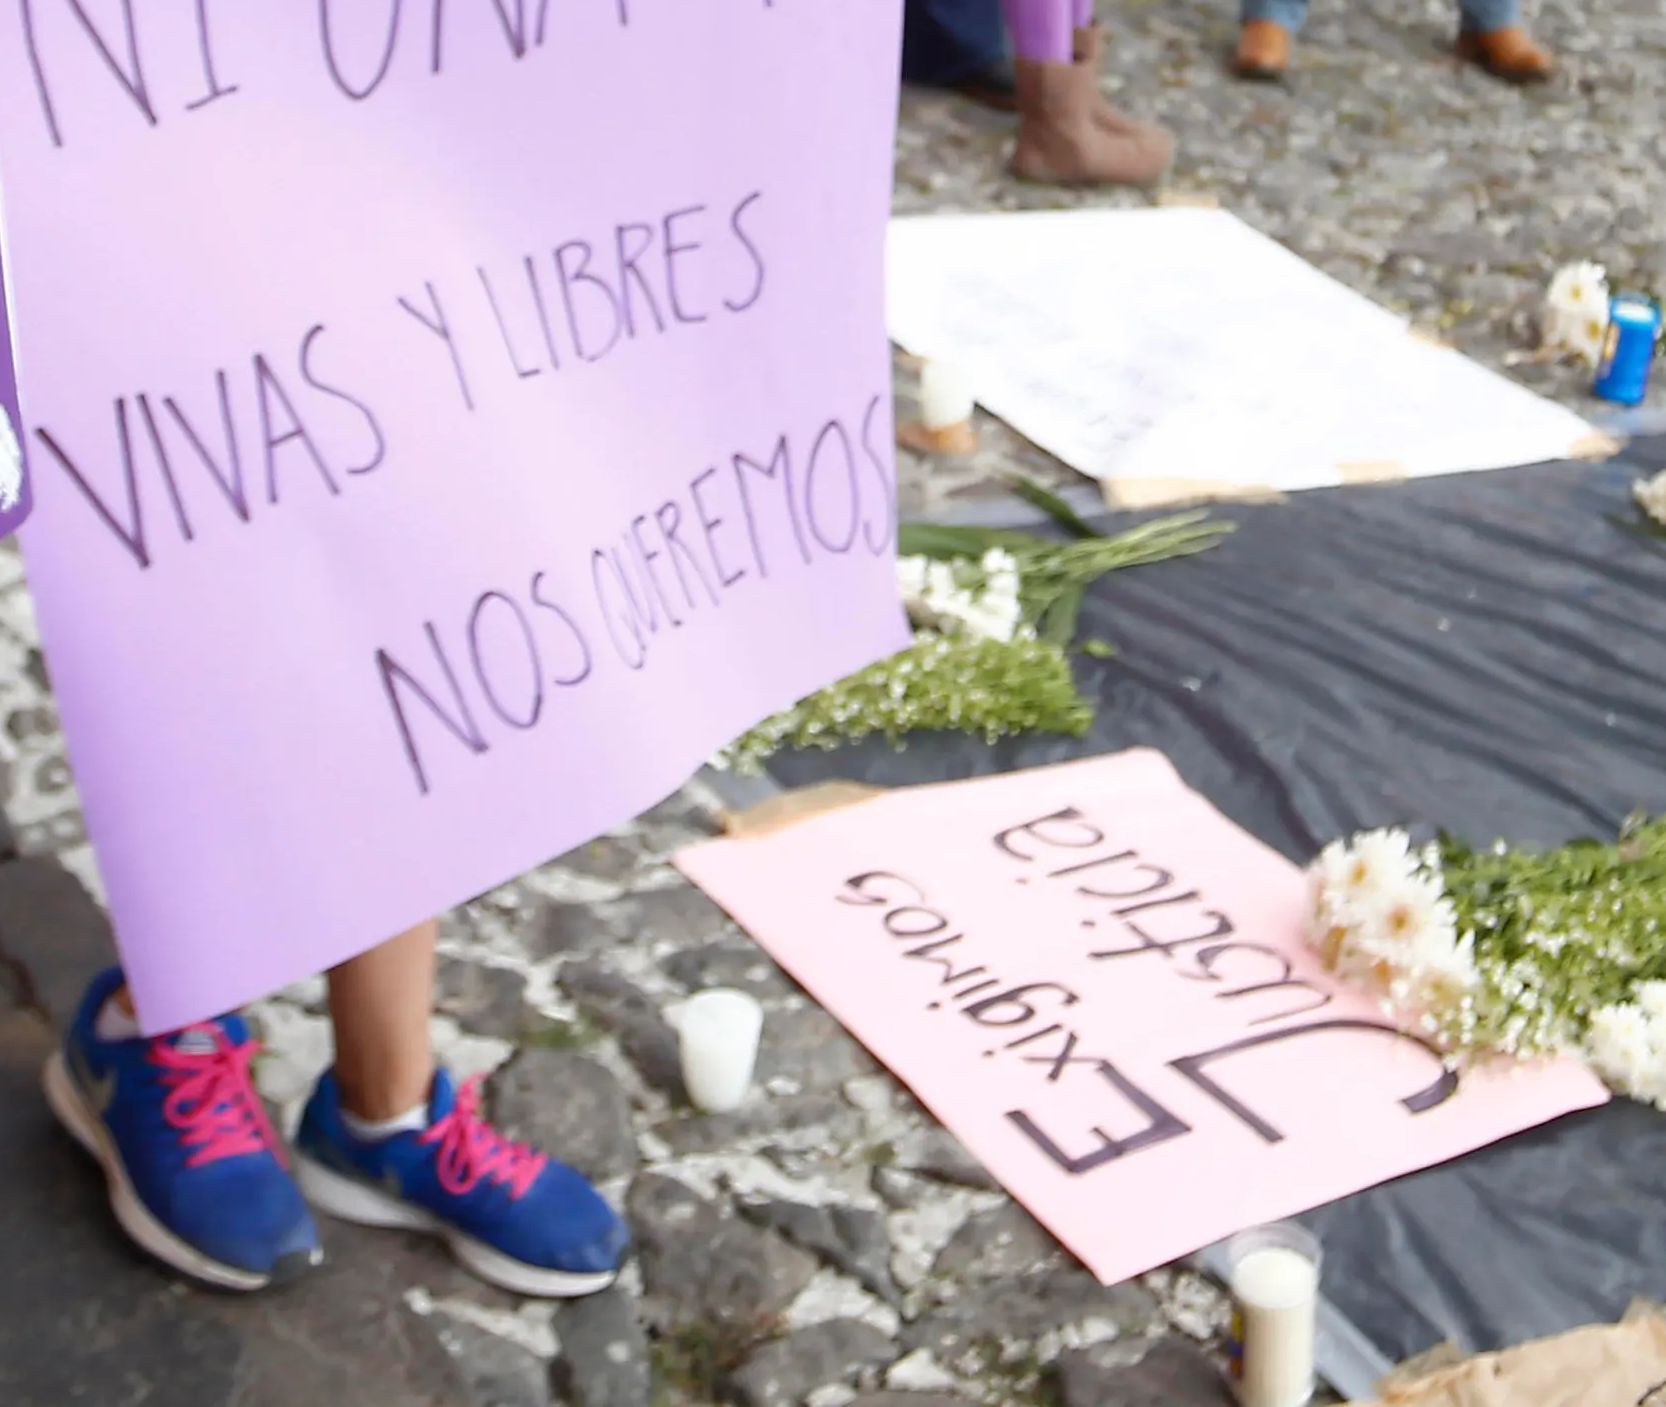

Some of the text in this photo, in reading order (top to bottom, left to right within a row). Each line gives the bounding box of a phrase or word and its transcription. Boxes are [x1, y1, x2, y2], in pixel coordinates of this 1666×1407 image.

[36, 325, 386, 568] VIVAS
[397, 280, 475, 410] Y
[477, 192, 765, 380] LIBRES
[375, 395, 897, 792] NOS QUEREMOS
[835, 870, 1195, 1175] Exigimos
[992, 806, 1459, 1146] Justicia
